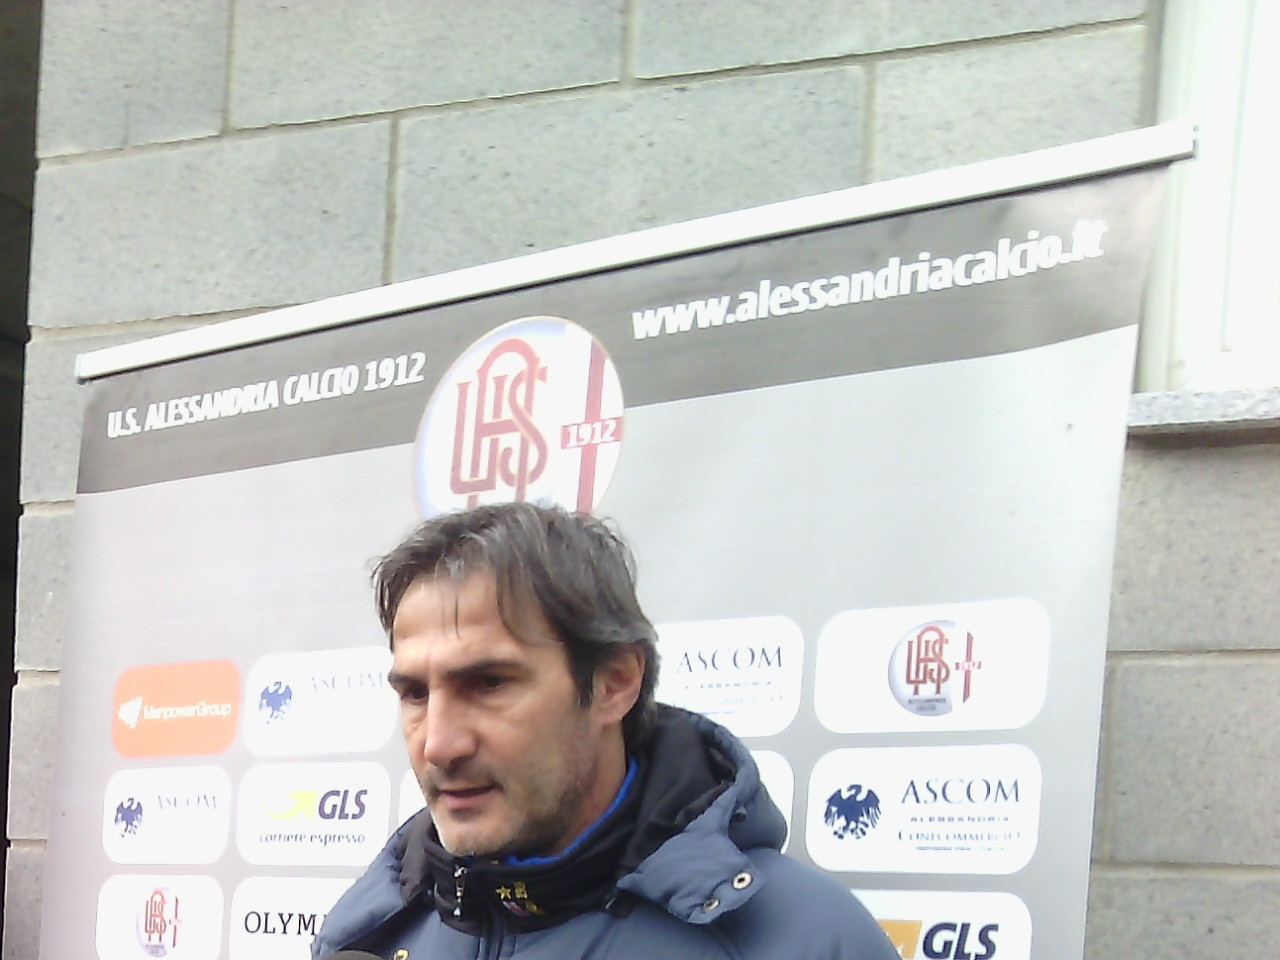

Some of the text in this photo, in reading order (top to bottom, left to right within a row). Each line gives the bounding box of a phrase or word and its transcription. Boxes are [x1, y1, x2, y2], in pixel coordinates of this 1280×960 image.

[631, 219, 1109, 341] www.alessandriacalcio.it
[107, 351, 426, 438] U.S. ALESSANDRIA CALCIO 1912
[564, 419, 616, 448] 1912
[677, 646, 782, 673] ASCOM
[318, 790, 368, 820] GLS
[901, 779, 1020, 804] ASCOM
[260, 832, 365, 847] corriere espresso
[244, 911, 326, 935] OLYM
